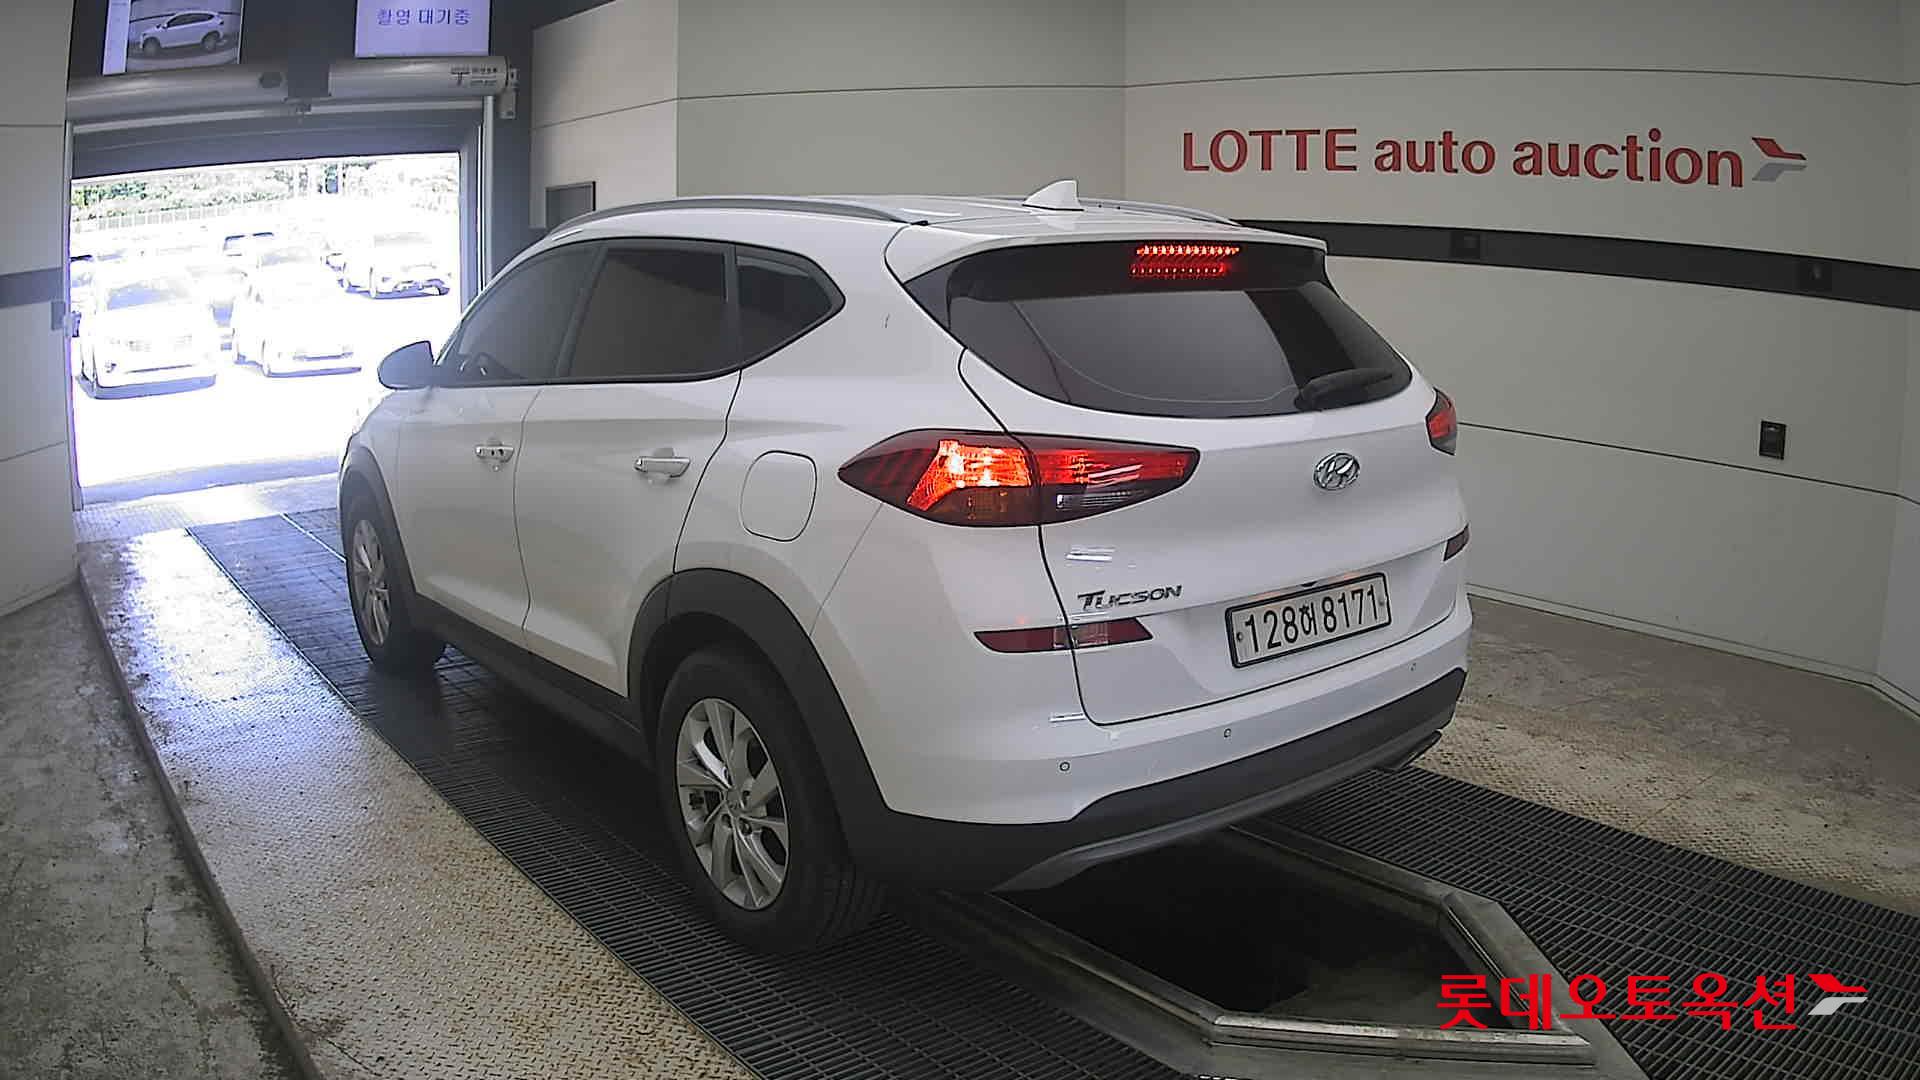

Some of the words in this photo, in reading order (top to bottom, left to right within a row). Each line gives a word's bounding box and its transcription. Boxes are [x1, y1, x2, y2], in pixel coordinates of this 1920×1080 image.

[419, 8, 471, 26] 대기중
[1183, 128, 1358, 173] LOTTE
[1374, 130, 1496, 175] auto
[1513, 128, 1744, 188] auction
[1077, 585, 1182, 611] TUCSON
[1244, 584, 1379, 653] 128허8171
